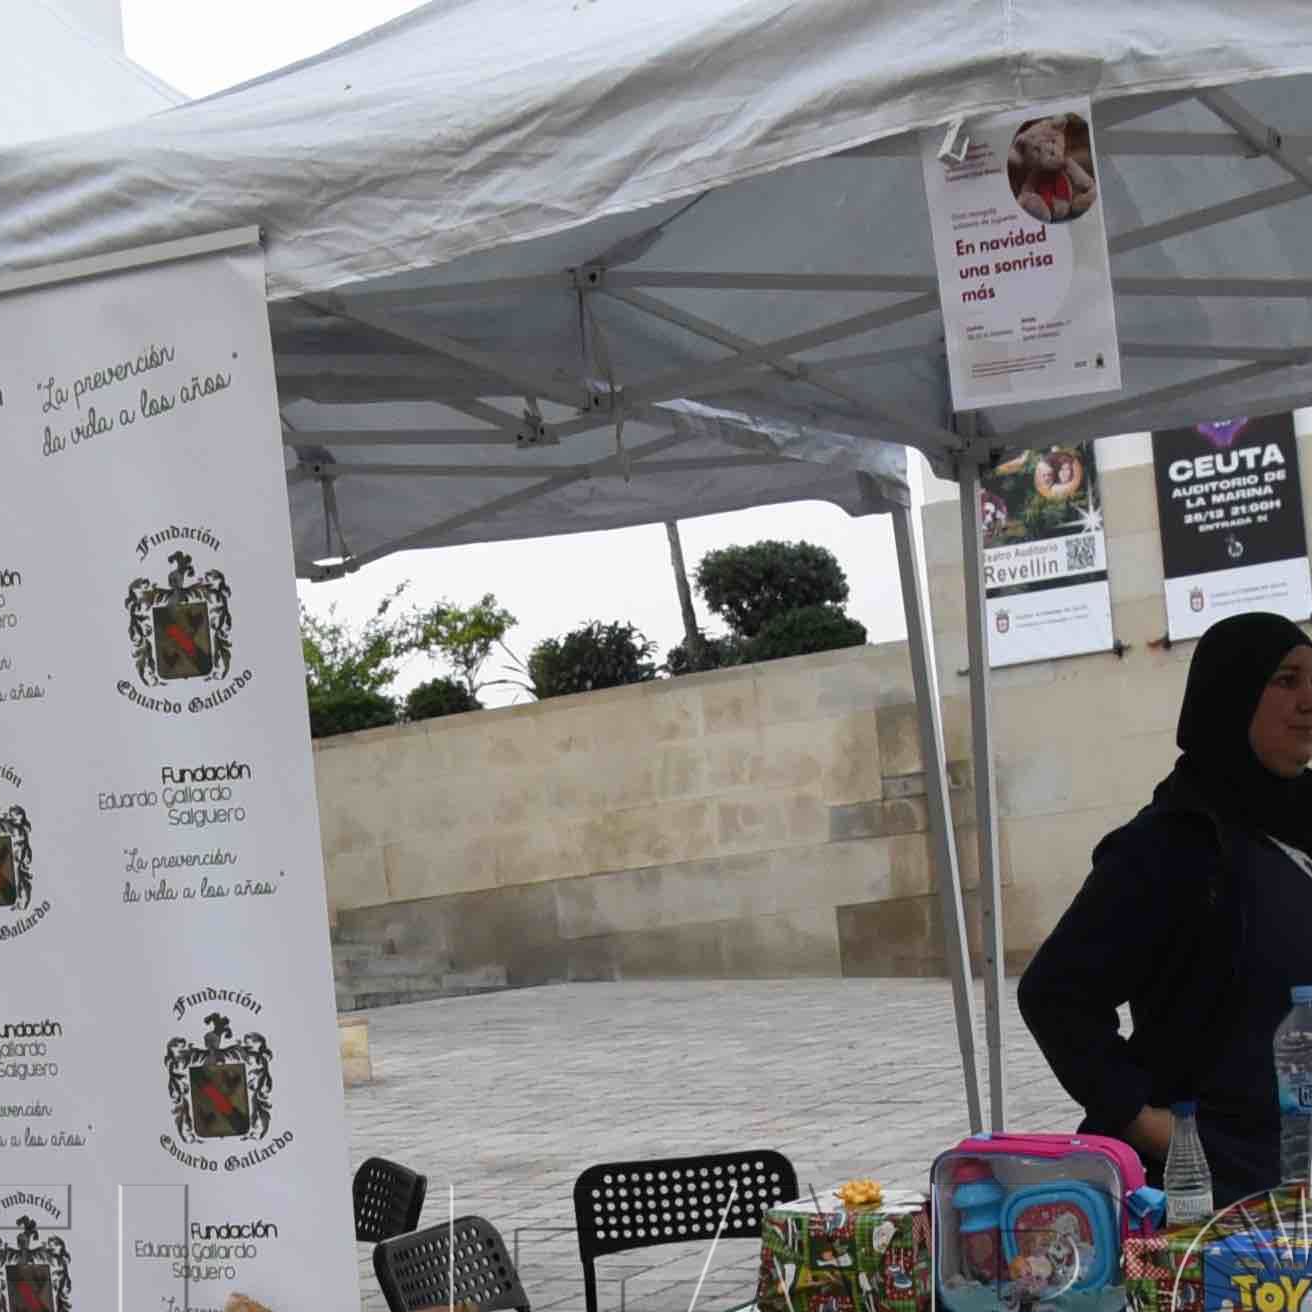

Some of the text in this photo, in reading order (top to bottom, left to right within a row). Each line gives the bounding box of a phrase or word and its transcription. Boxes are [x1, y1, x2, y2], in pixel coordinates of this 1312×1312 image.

[956, 225, 1047, 257] En navidad
[959, 252, 1053, 279] una sonrisa
[962, 284, 995, 302] más
[74, 345, 174, 400] prevención
[43, 429, 65, 456] da
[71, 408, 113, 444] vida
[120, 409, 134, 426] a
[140, 389, 175, 417] los
[1169, 444, 1284, 482] CEUTA
[1172, 470, 1286, 498] AUDITORIO DE
[1186, 485, 1273, 508] LA MARINA
[136, 525, 221, 564] Fundación
[117, 668, 252, 714] Eduardo Gallardo
[162, 761, 251, 785] Fundación
[99, 785, 232, 810] Eduardo Gallardo
[168, 807, 245, 827] Salguero
[152, 848, 237, 877] prevención
[123, 881, 140, 902] da
[144, 880, 177, 902] vida
[183, 886, 195, 898] a
[200, 877, 229, 898] los
[173, 987, 262, 1021] Fundación
[10, 1135, 21, 1146] a
[25, 1128, 48, 1147] los
[160, 1131, 294, 1171] Eduardo Gallardo
[191, 1220, 277, 1240] Fundación
[135, 1241, 257, 1262] Eduardo Gallardo
[1232, 1274, 1312, 1312] TOY
